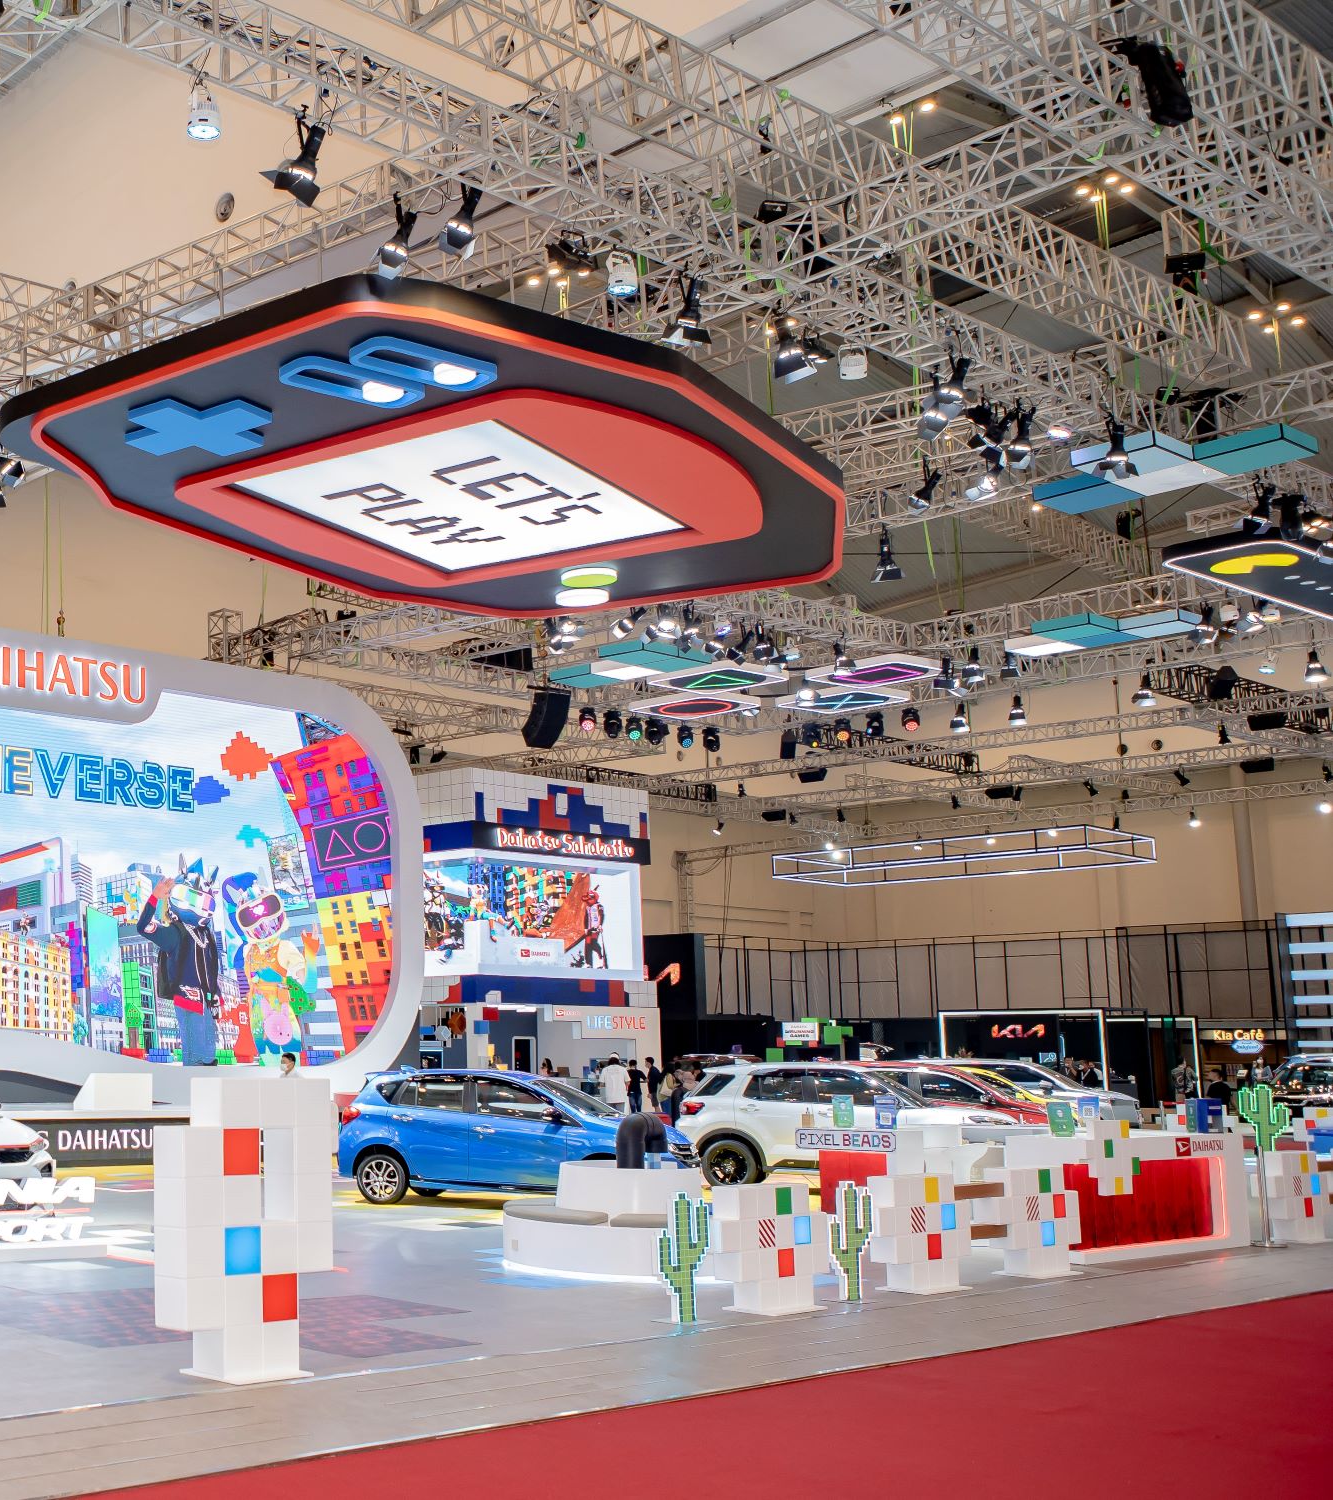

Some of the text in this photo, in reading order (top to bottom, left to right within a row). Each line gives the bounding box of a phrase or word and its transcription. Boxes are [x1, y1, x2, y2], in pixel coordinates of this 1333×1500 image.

[430, 455, 603, 526] LET'S
[320, 482, 506, 546] PLAY
[497, 827, 562, 851] Daihatsu
[586, 1015, 647, 1031] LIFESTYLE
[991, 1023, 1046, 1039] KIA
[1213, 1029, 1234, 1041] Kia
[57, 1128, 154, 1151] DAIHATSU
[799, 1132, 892, 1149] PIXEL BEADS
[1192, 1139, 1224, 1152] DAIHATSU
